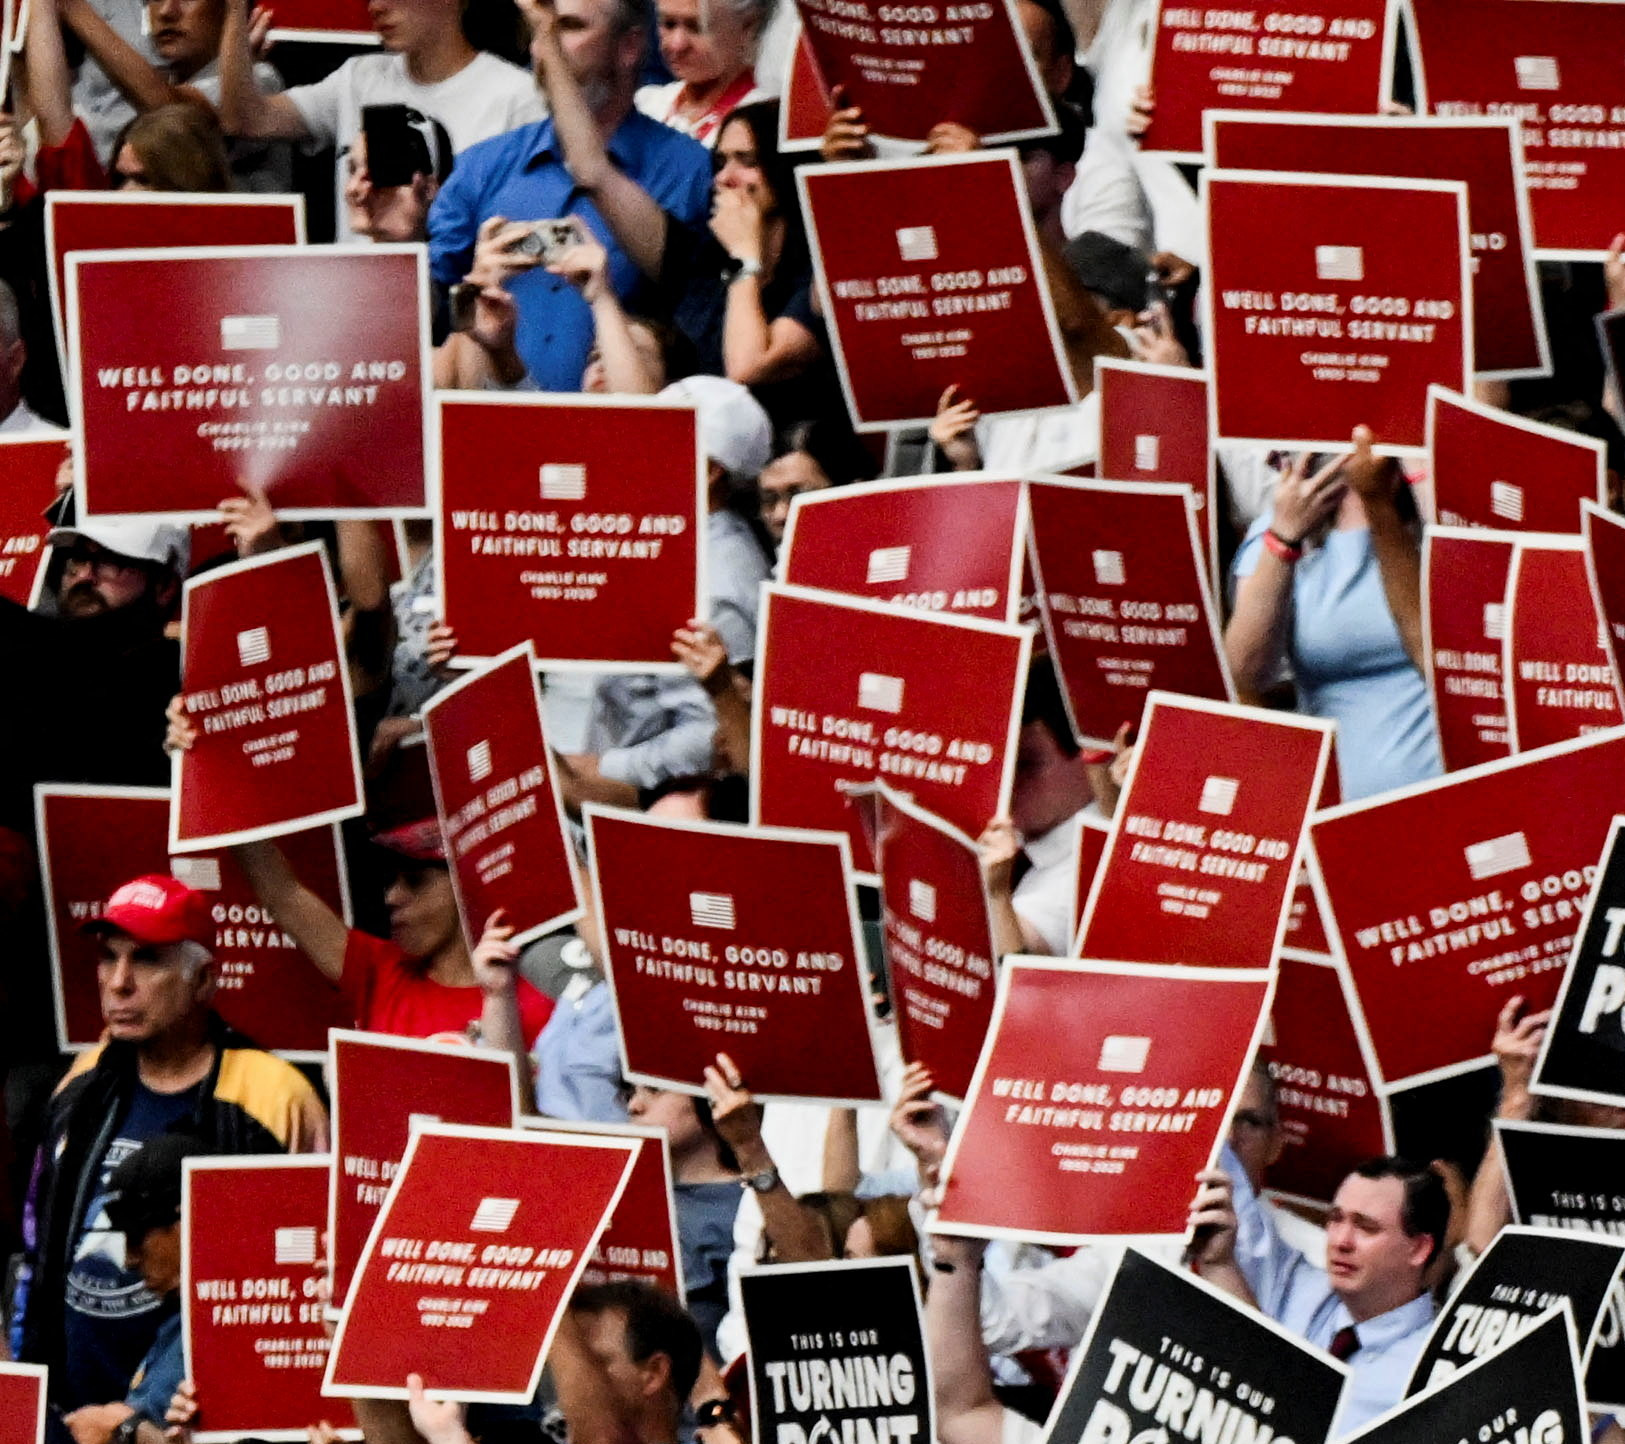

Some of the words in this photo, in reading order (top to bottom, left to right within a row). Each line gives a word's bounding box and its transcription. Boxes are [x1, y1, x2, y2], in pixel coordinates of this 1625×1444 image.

[615, 928, 657, 951] WELL
[725, 945, 788, 968] GOOD
[796, 952, 843, 971] AND
[636, 956, 717, 986] FAITHFUL
[724, 970, 821, 994] SERVANT
